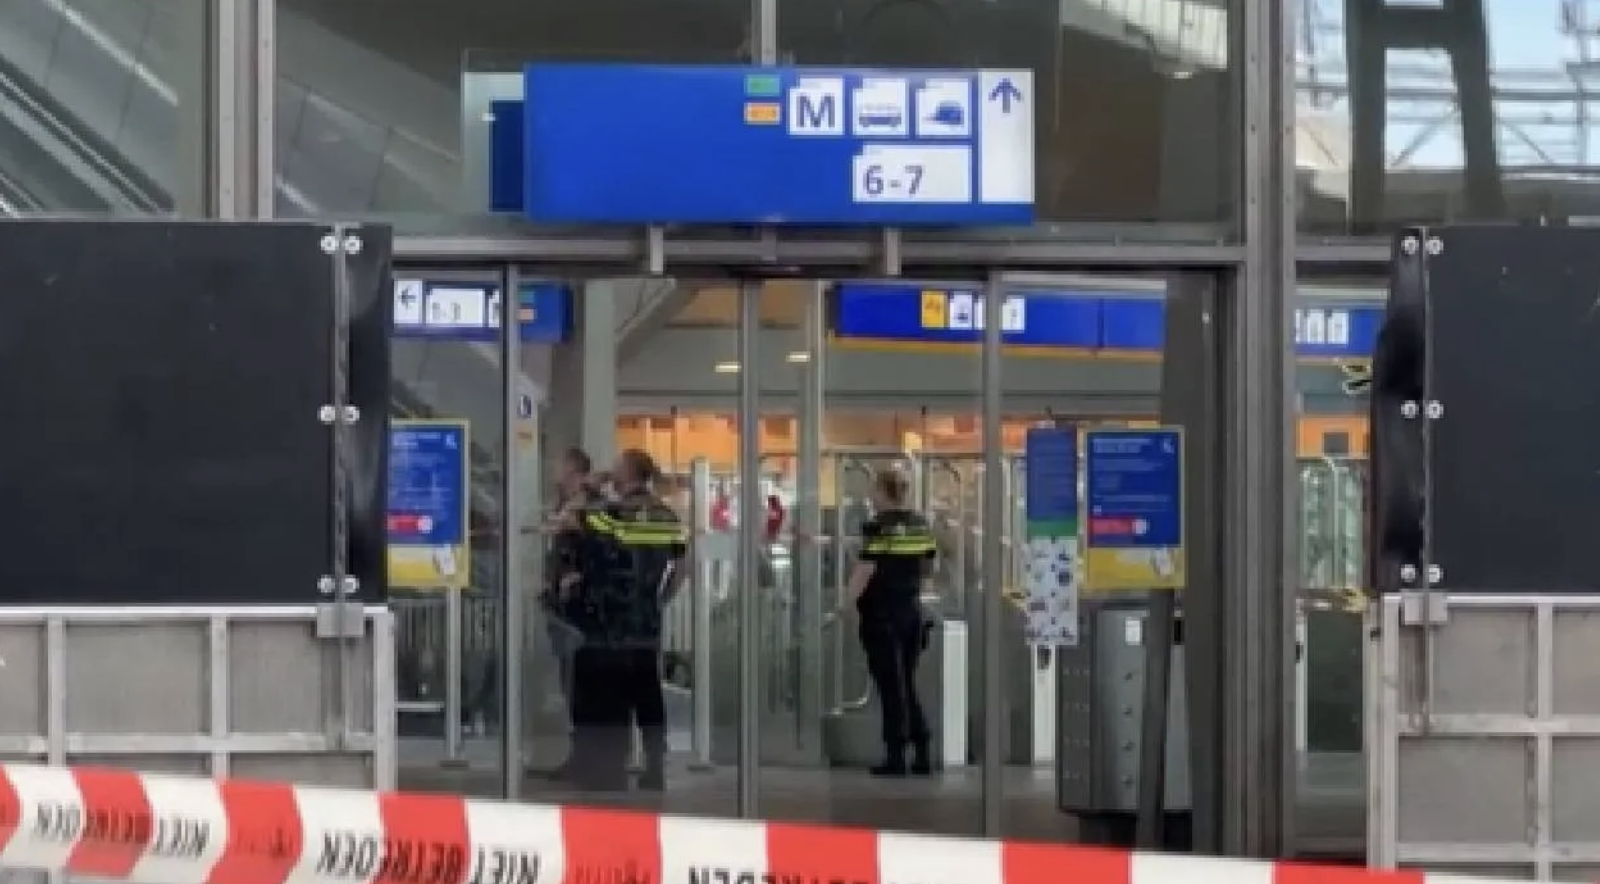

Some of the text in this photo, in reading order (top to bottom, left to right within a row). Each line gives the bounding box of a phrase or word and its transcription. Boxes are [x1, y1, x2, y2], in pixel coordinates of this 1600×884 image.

[795, 94, 836, 128] M
[864, 164, 926, 196] 6-7
[471, 846, 541, 884] NIET
